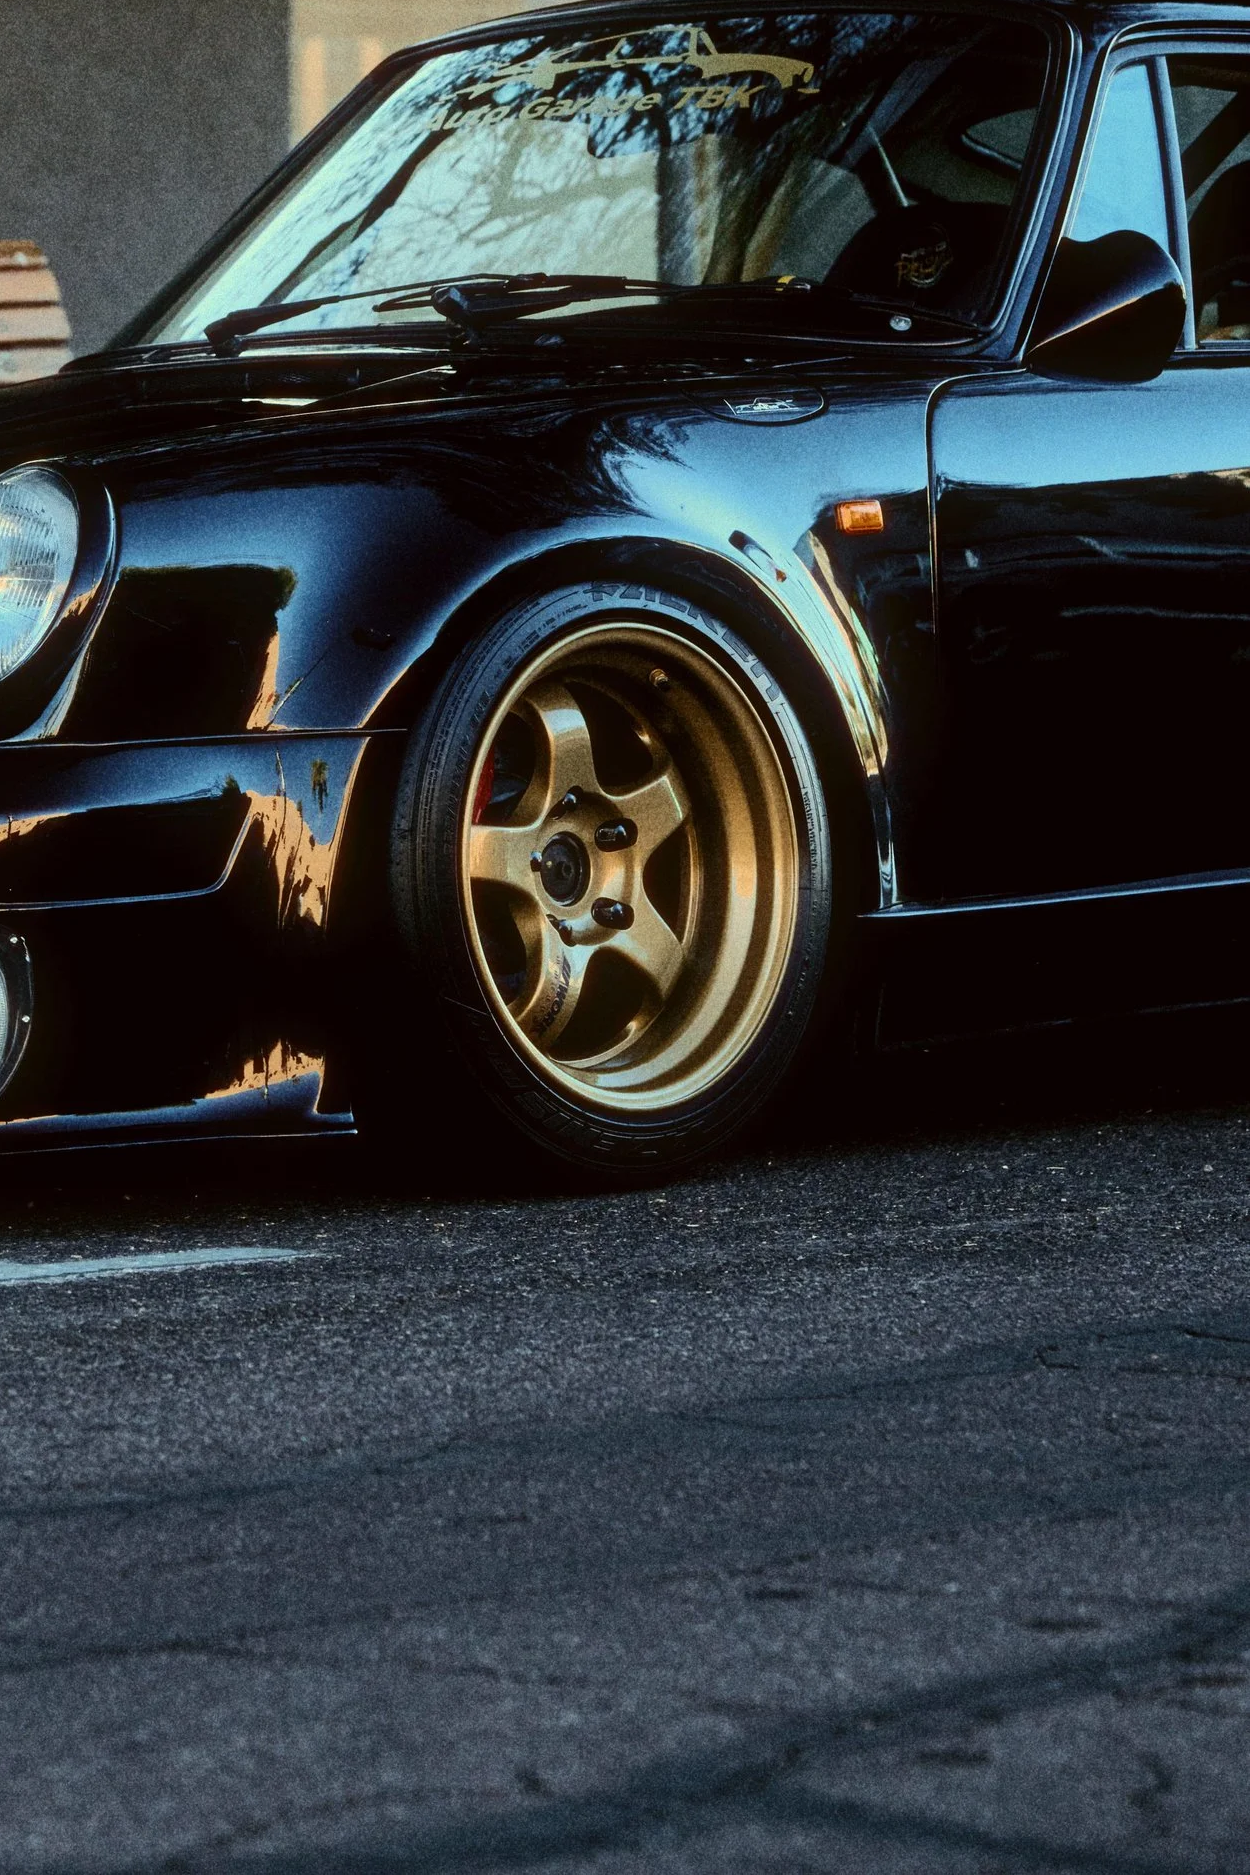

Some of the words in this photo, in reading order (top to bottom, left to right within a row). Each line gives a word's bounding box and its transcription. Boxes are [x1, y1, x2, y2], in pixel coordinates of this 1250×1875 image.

[427, 101, 512, 131] Auto
[519, 92, 663, 121] Garage
[672, 84, 767, 110] TBK
